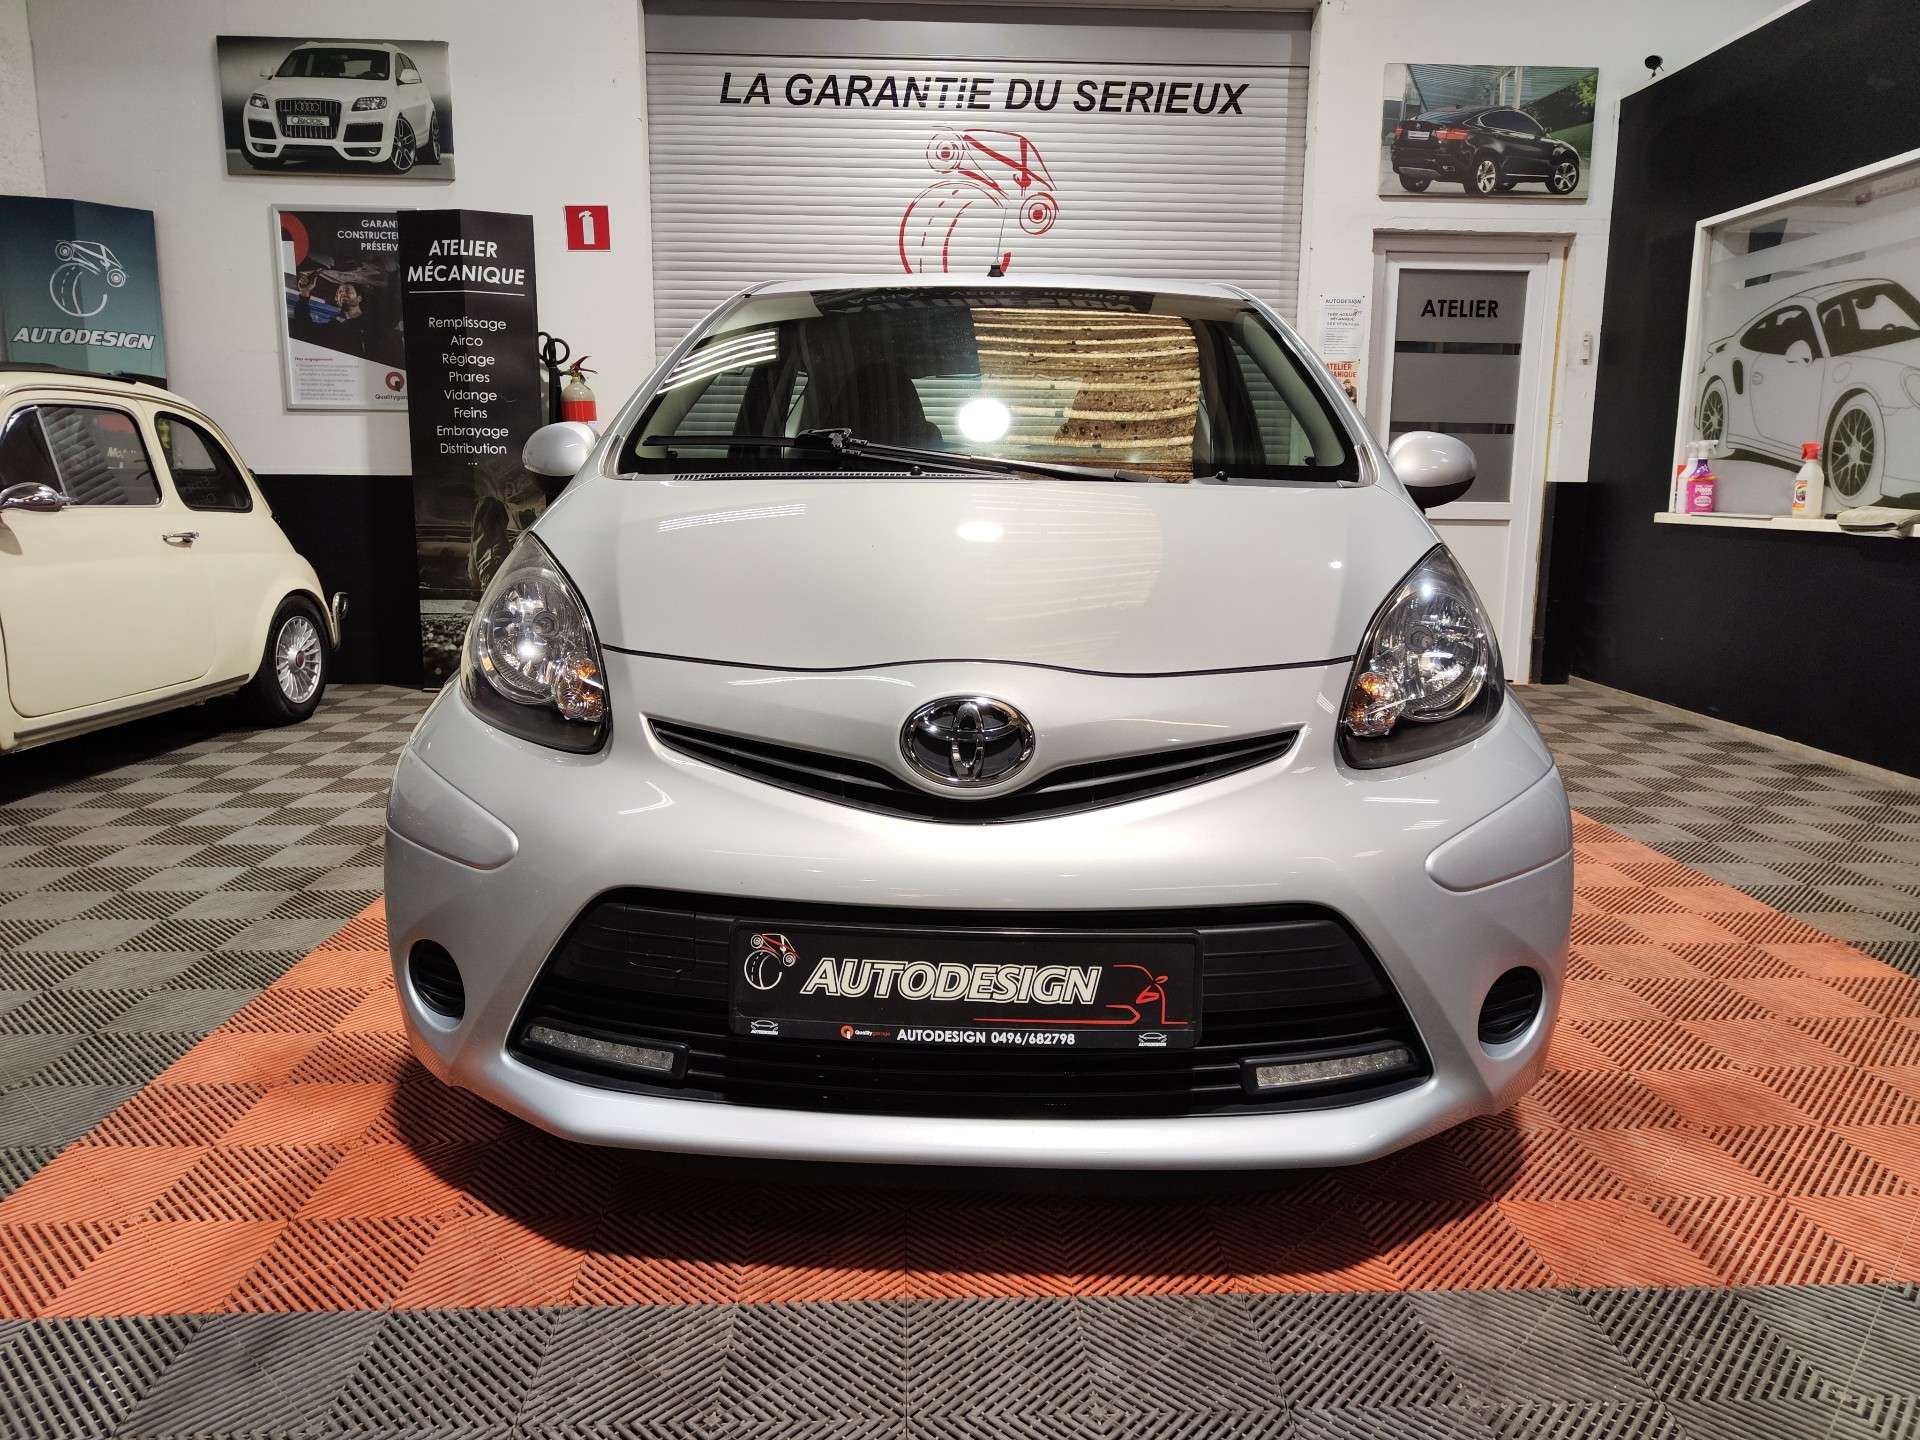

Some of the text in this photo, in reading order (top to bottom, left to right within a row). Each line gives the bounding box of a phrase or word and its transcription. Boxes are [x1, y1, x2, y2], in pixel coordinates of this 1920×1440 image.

[720, 72, 1250, 115] LA GARANTIE DU SERIEUX
[428, 239, 498, 258] ATELIER
[407, 260, 525, 285] MÉCANIQUE
[1421, 299, 1498, 318] ATELIER
[428, 316, 507, 332] Remplissage
[12, 327, 156, 350] AUTODESIGN
[450, 334, 483, 346] Airco
[442, 352, 495, 367] Réglage
[448, 371, 490, 383] Phares
[444, 389, 498, 404] Vidange
[454, 407, 488, 419] Freins
[436, 425, 509, 440] Embrayage
[440, 442, 508, 455] Distribution
[800, 957, 1102, 1005] AUTODESIGN
[897, 1028, 1076, 1046] AUTODESIGN 0496/682798
